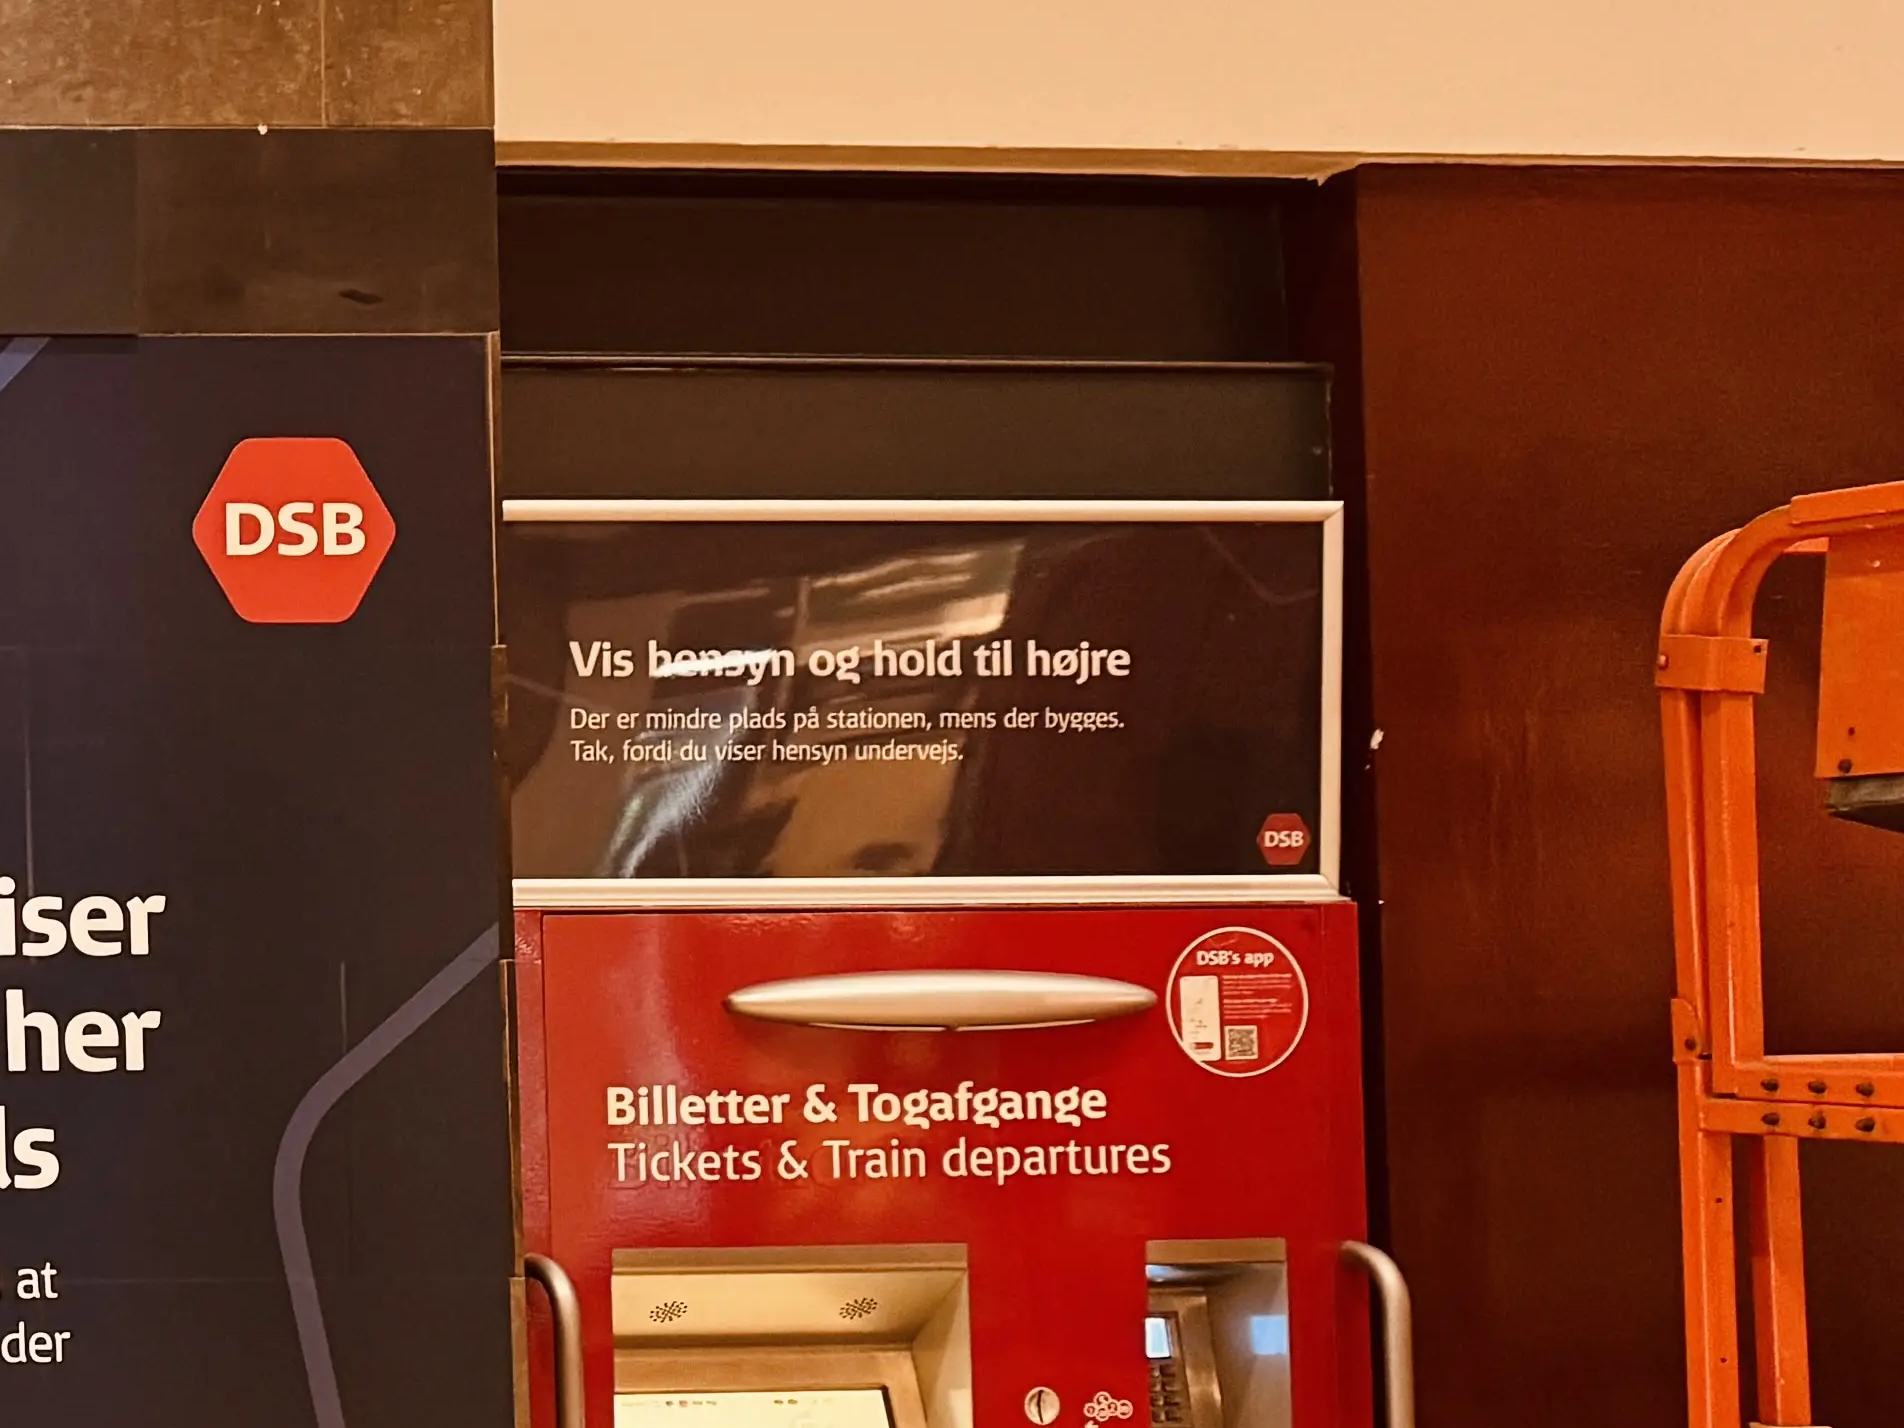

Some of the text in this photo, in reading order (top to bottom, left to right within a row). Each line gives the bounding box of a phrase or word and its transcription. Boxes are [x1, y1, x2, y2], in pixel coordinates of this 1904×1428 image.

[226, 502, 365, 556] DSB
[570, 637, 1130, 684] Vis og hold til højre
[571, 739, 964, 766] Tak, viser hensyn undervejs.
[1264, 829, 1303, 849] DSB
[6, 989, 161, 1072] her
[17, 1263, 58, 1299] at
[1, 1321, 70, 1362] der
